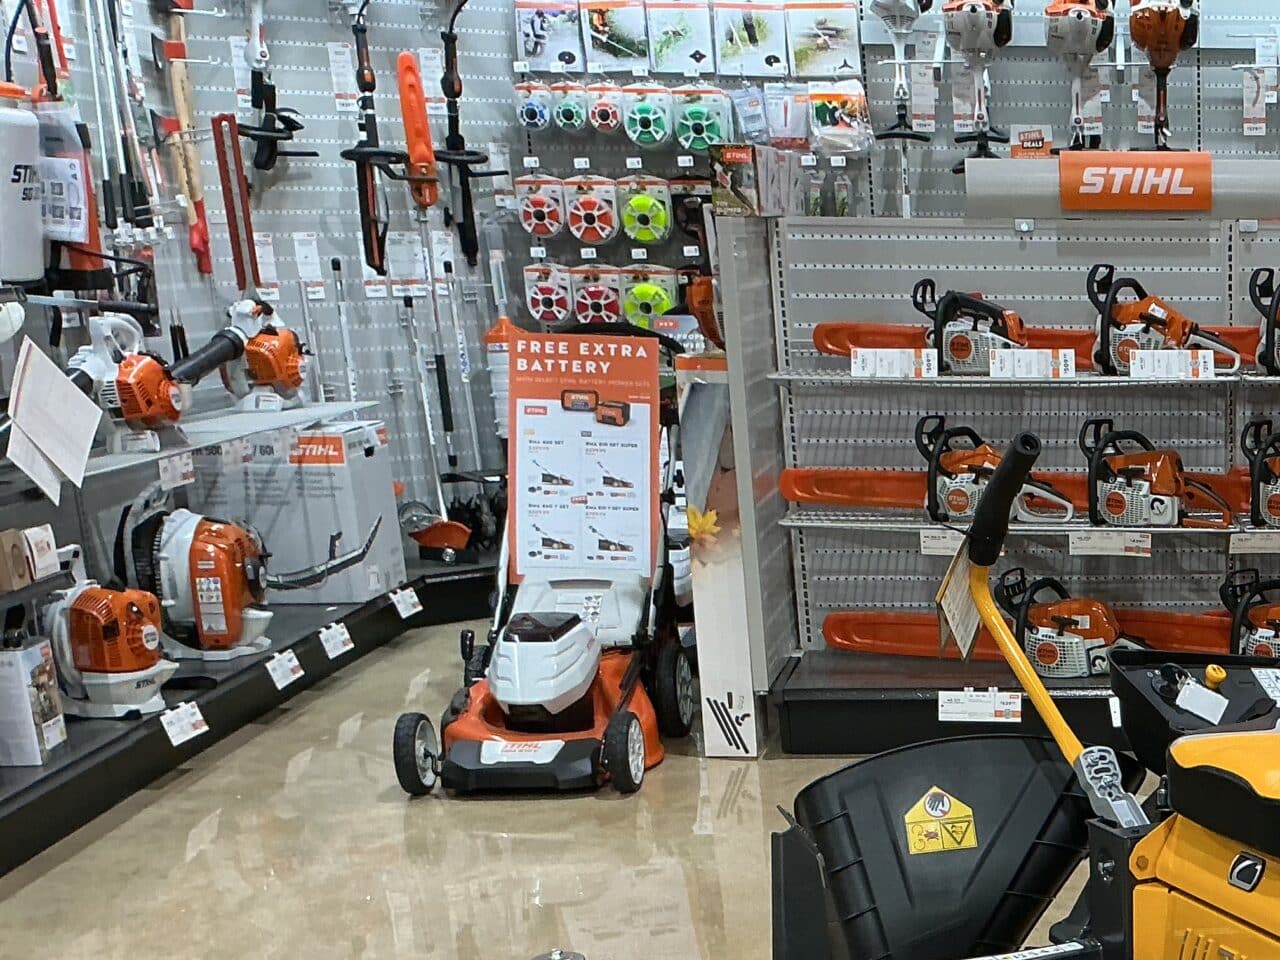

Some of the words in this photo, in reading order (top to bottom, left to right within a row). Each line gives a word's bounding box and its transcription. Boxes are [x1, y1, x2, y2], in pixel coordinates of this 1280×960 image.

[1019, 131, 1042, 142] STIHL
[1023, 140, 1043, 148] DEALS
[1079, 167, 1194, 195] STIHL
[517, 340, 569, 355] FREE
[579, 342, 648, 358] EXTRA
[517, 359, 611, 374] BATTERY
[291, 444, 339, 456] STIHL
